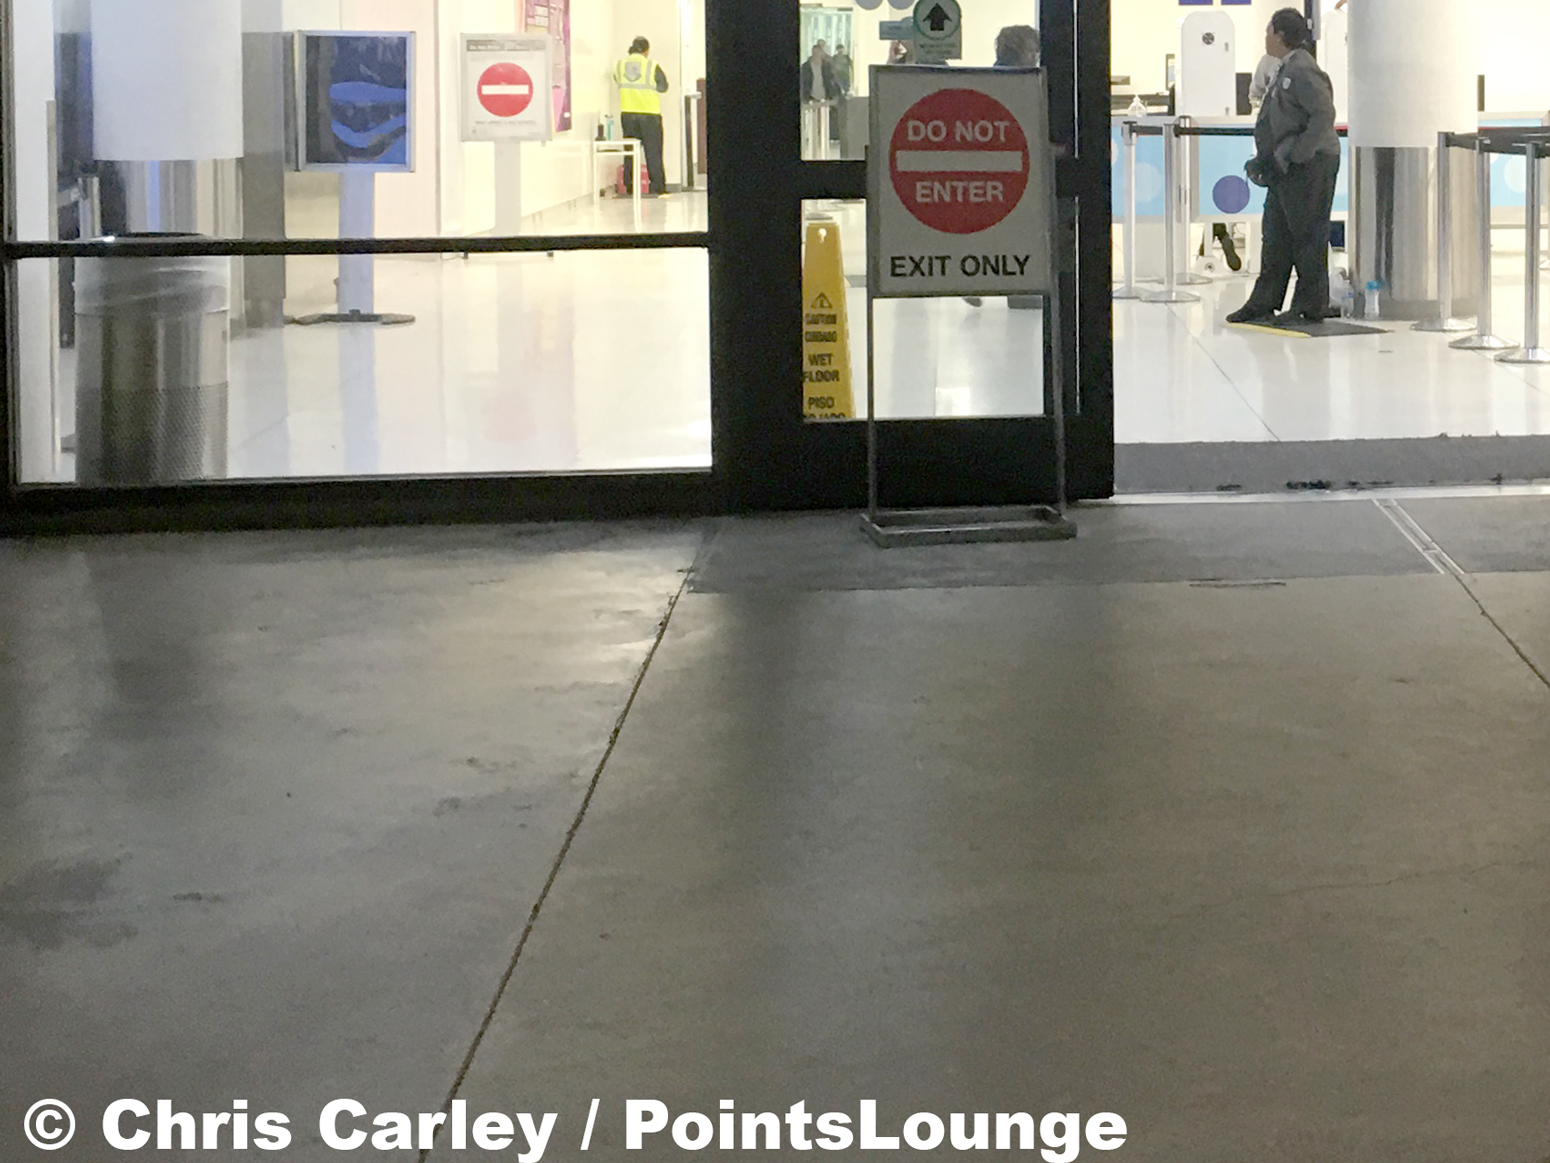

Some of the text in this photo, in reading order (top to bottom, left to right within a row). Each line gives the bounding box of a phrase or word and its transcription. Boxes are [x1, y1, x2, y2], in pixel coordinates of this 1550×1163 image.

[907, 120, 1011, 143] DO NOT
[915, 181, 1004, 203] ENTER
[890, 254, 1031, 277] EXIT ONLY
[808, 353, 833, 366] WET
[808, 396, 835, 410] PISO
